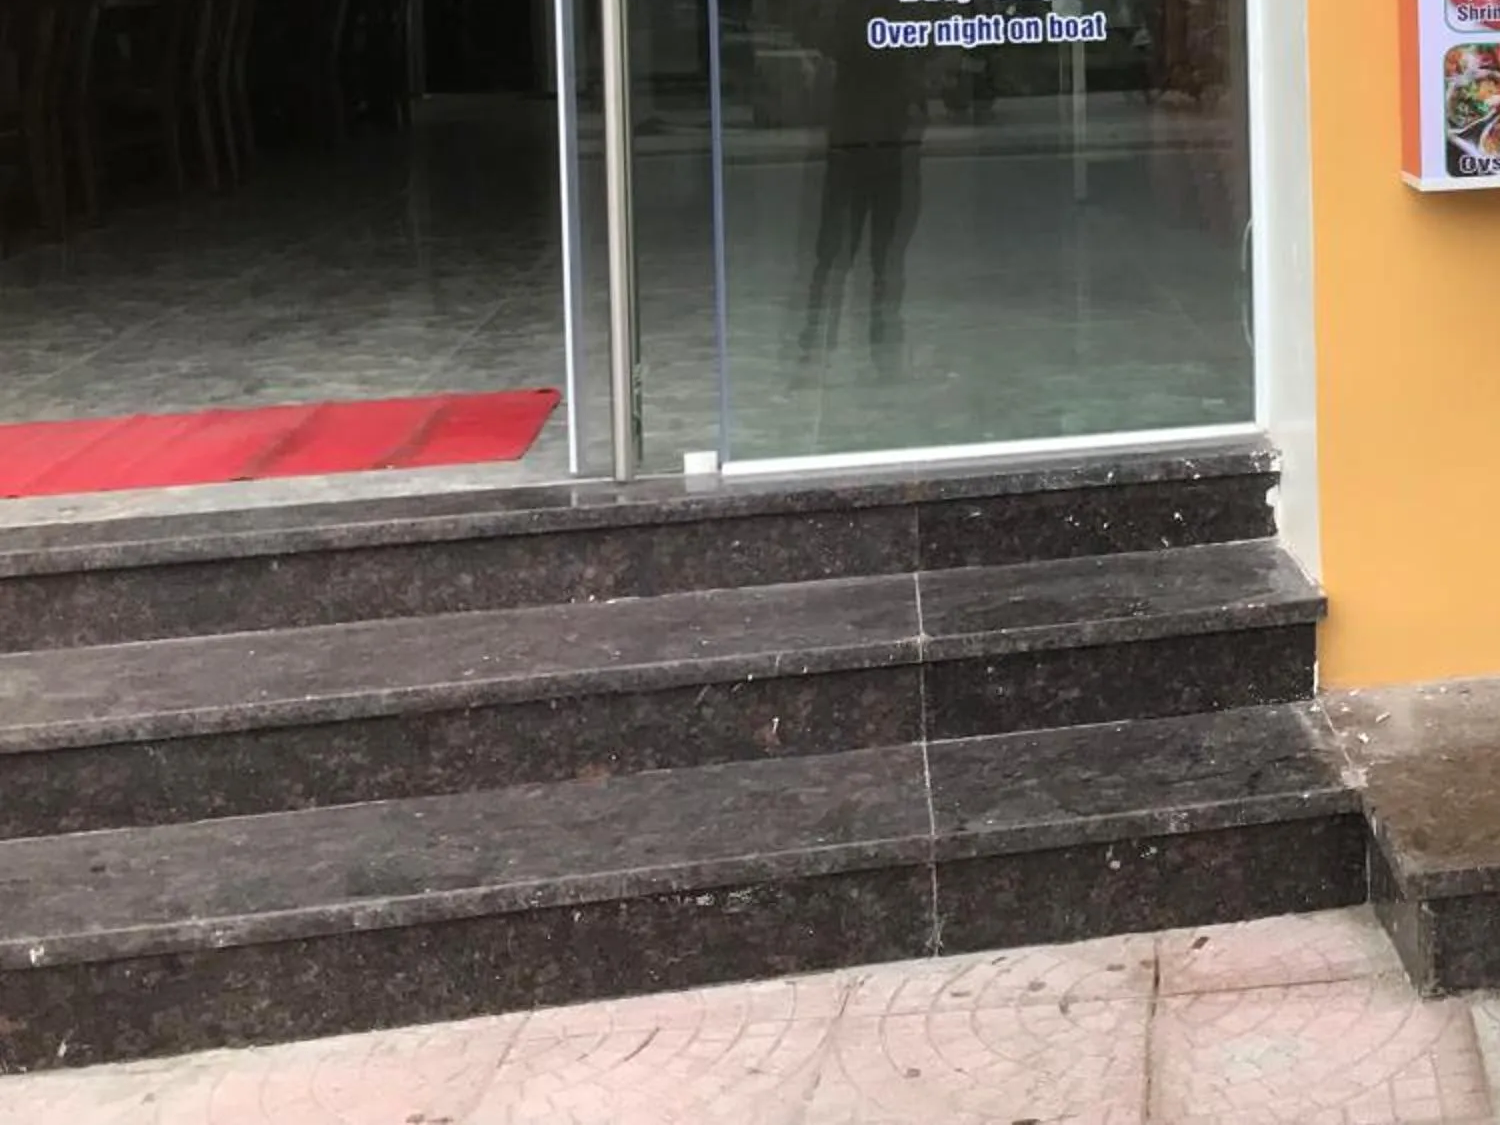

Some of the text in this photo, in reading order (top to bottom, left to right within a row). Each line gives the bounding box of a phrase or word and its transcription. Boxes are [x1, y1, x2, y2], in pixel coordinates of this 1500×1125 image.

[868, 13, 1106, 46] Over night on boat
